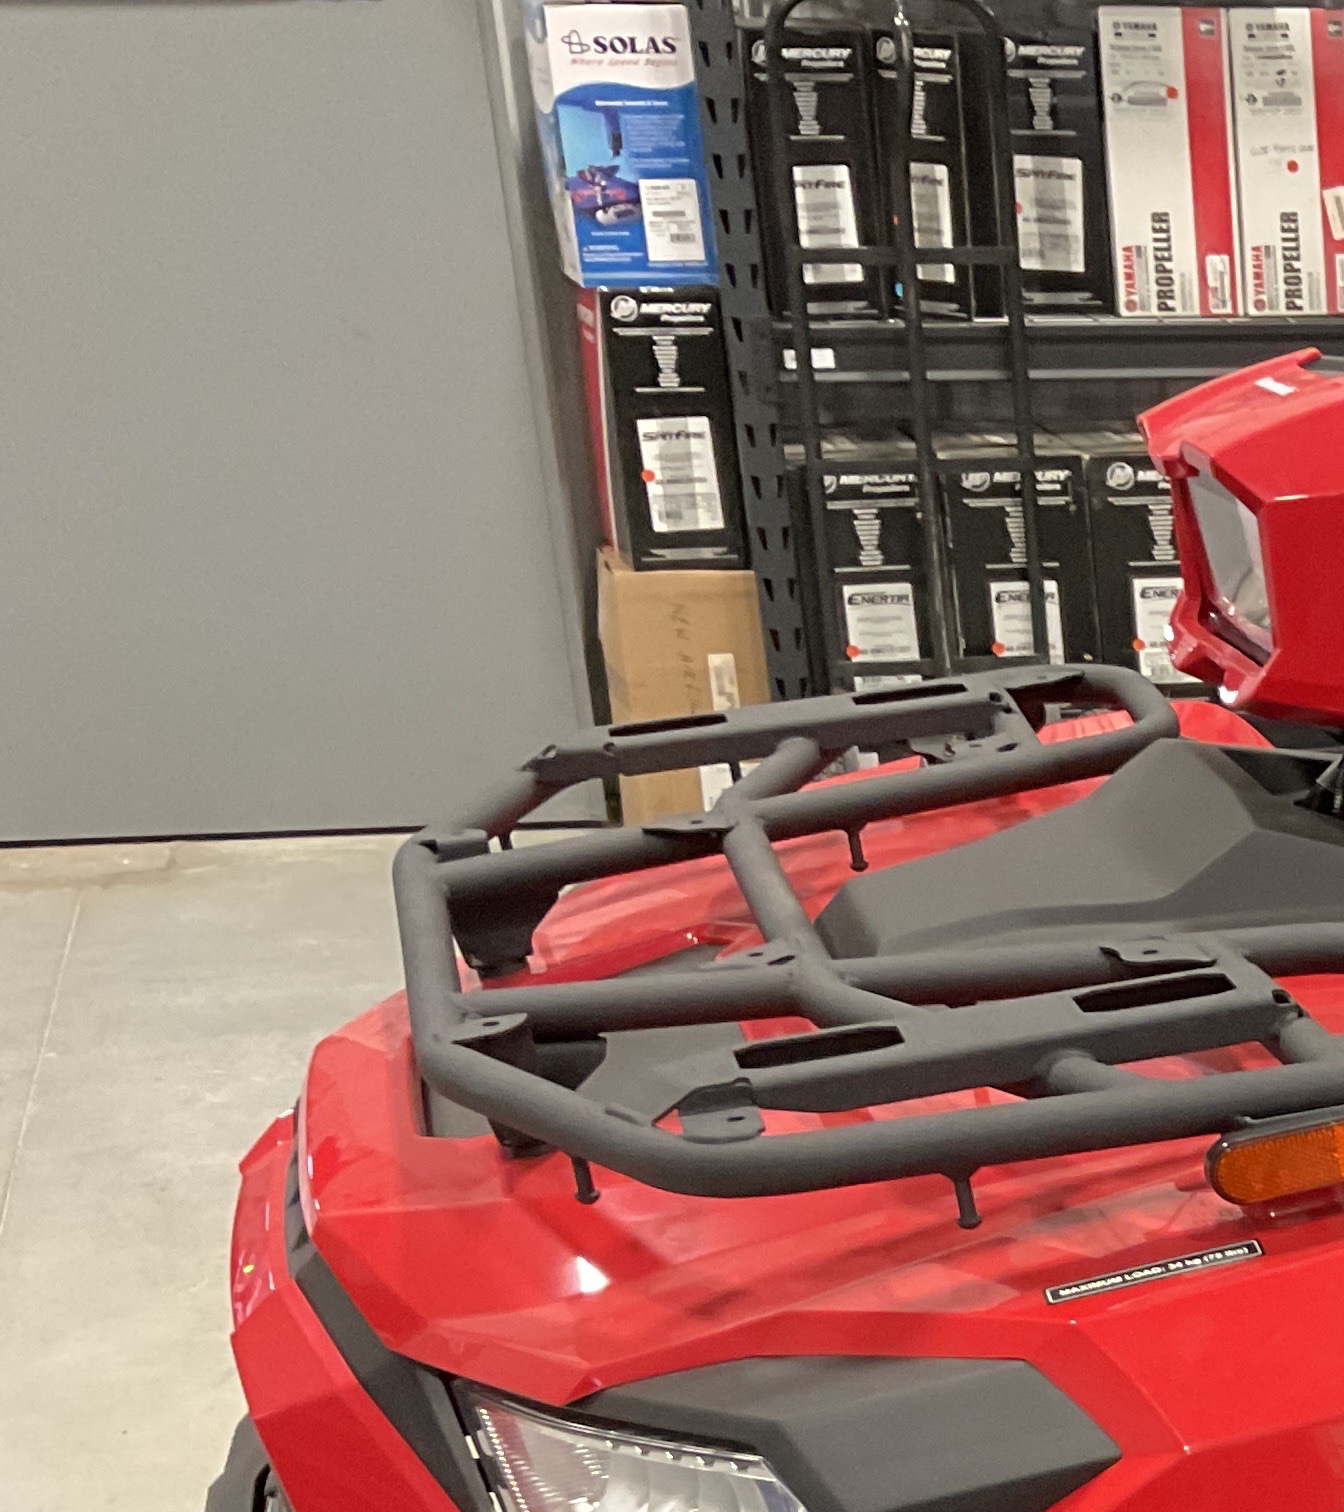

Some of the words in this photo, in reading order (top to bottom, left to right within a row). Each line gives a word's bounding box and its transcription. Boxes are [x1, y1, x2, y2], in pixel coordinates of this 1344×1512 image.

[593, 36, 677, 54] SOLAS
[781, 47, 851, 60] MERCURY
[1018, 45, 1086, 57] MERCURY
[1122, 246, 1138, 297] YAMAHA
[1151, 212, 1177, 312] PROPELLER
[1251, 246, 1266, 297] YAMAHA
[1279, 212, 1304, 311] PROPELLER
[640, 303, 712, 314] MERCURY
[1058, 1275, 1123, 1297] MAXIMUM
[1124, 1265, 1166, 1282] LOAD:
